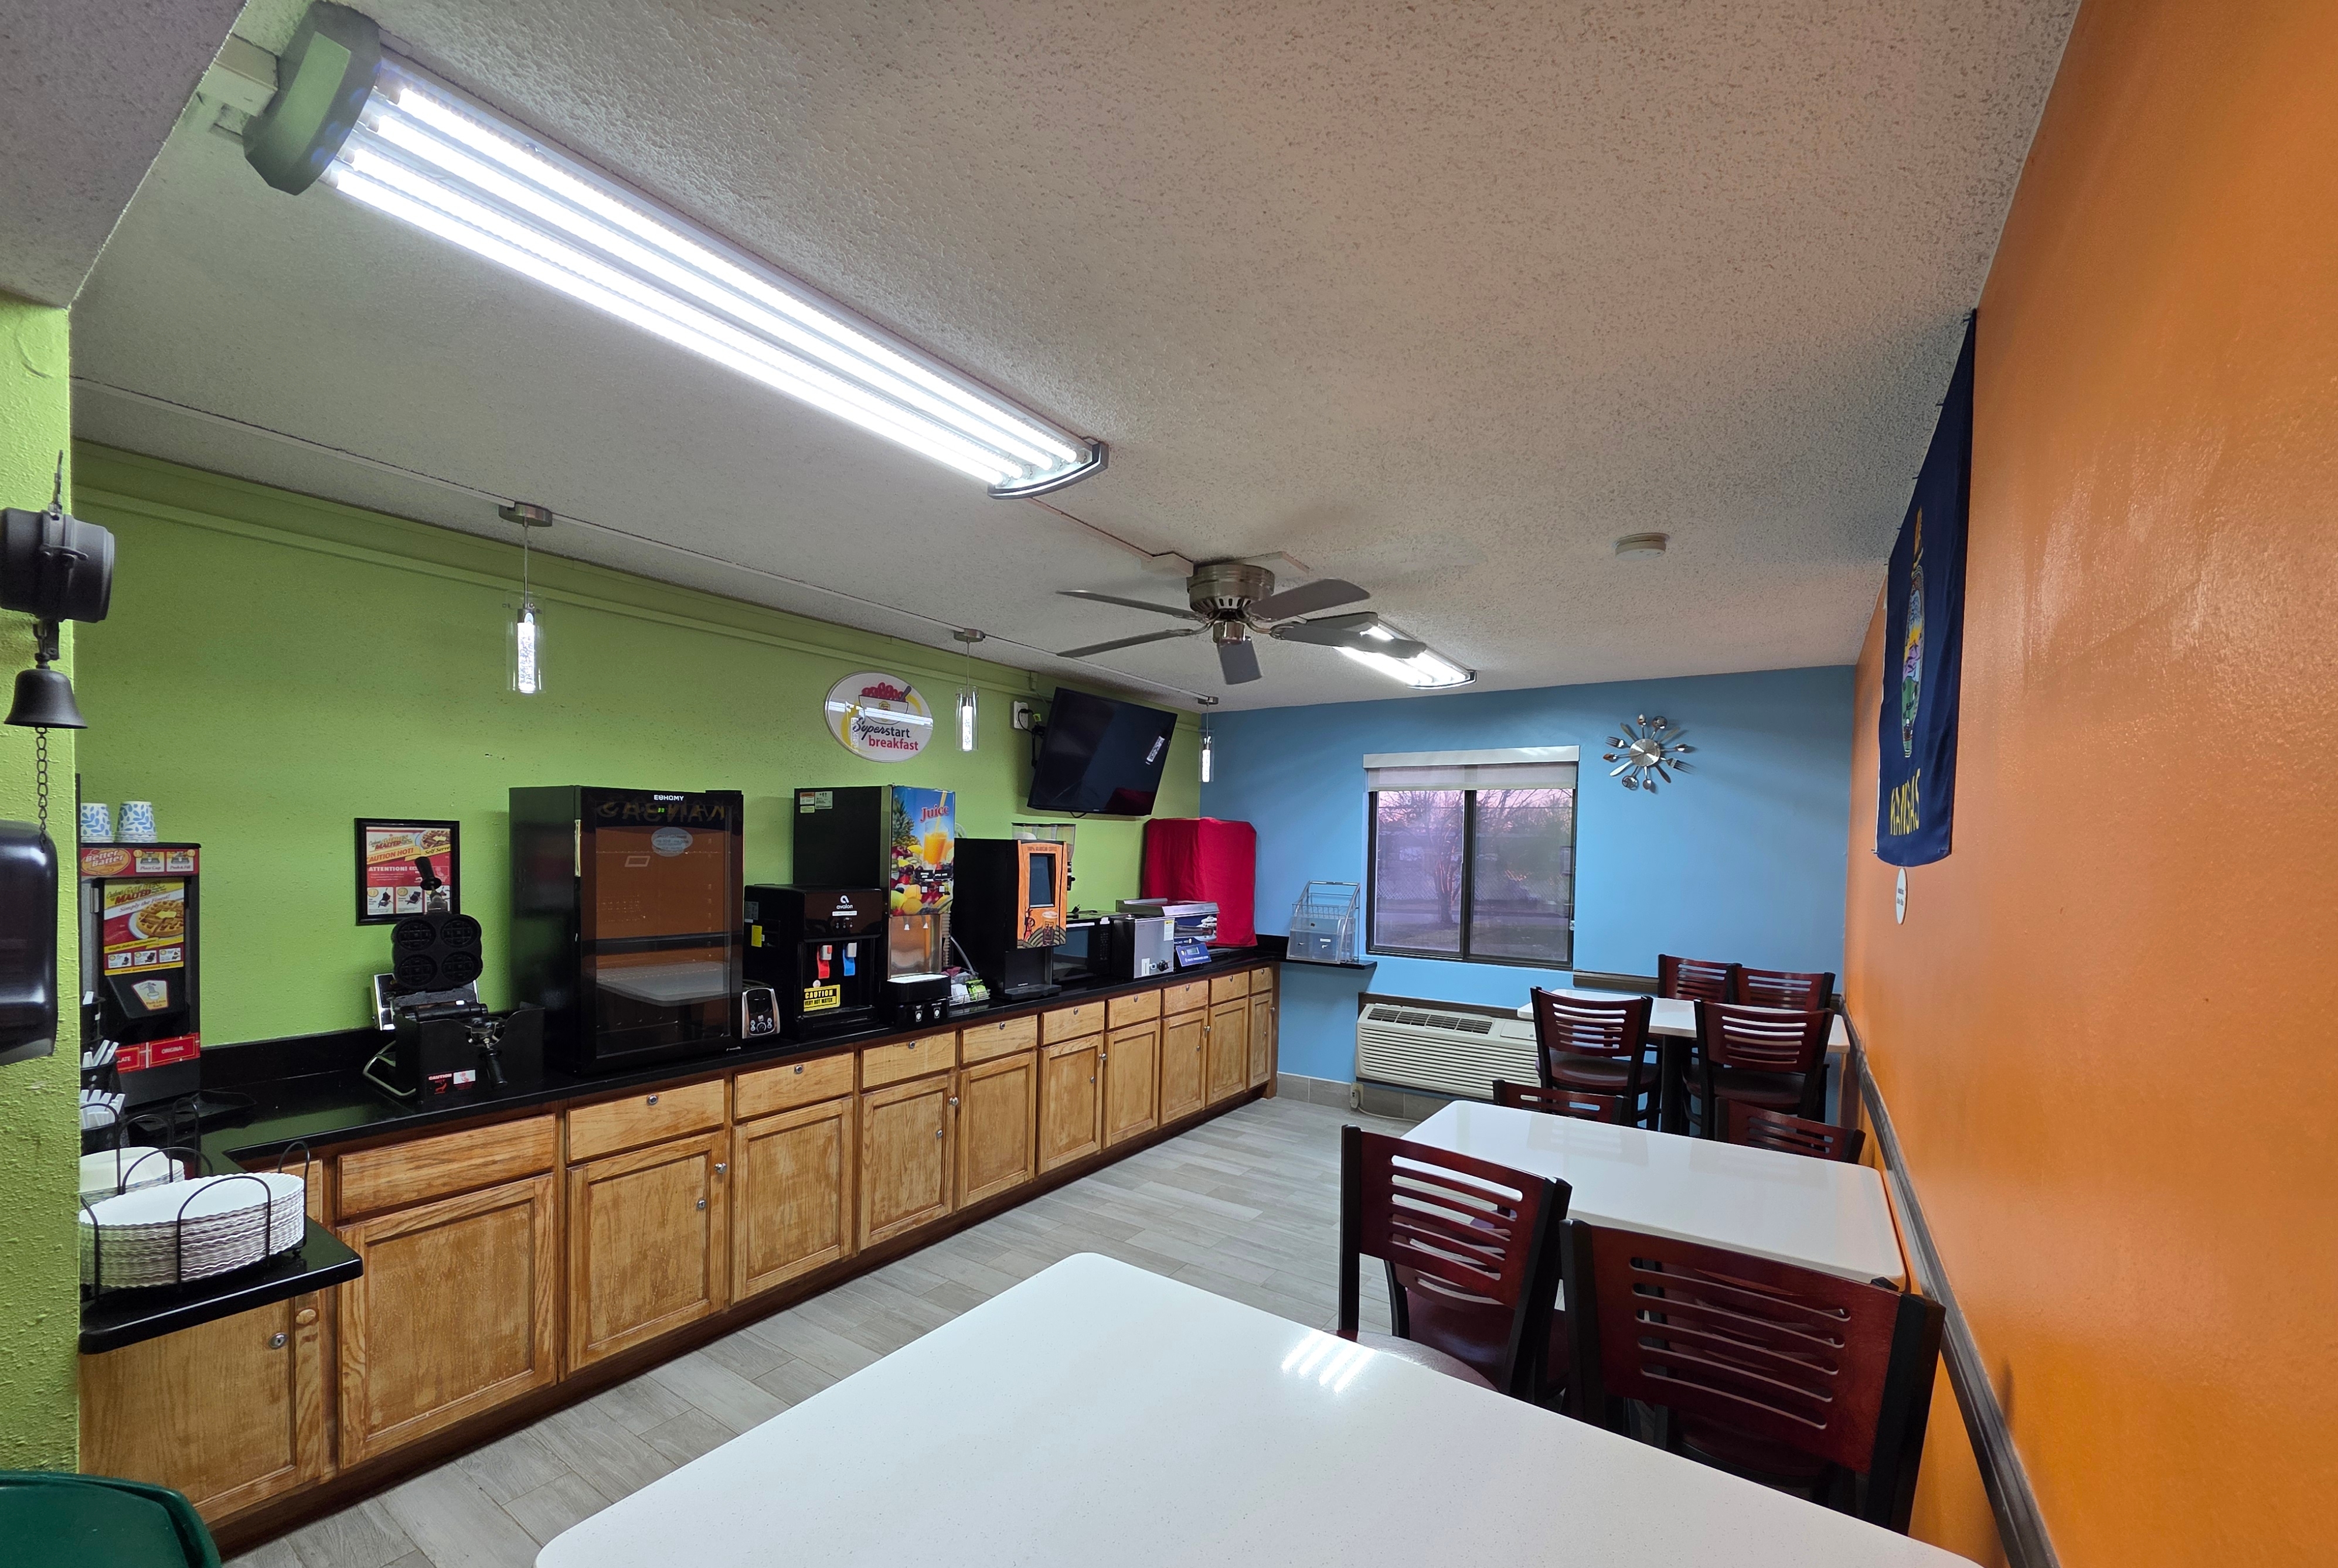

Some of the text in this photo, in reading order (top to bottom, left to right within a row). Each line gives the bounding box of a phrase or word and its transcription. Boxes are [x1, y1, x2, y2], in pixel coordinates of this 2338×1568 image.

[852, 717, 910, 741] Superstart
[869, 735, 919, 751] breakfast
[1890, 768, 1921, 836] KANSAS
[920, 804, 950, 823] Juice
[375, 841, 401, 850] MALTED
[397, 847, 414, 856] HOT!
[86, 850, 119, 863] Better
[92, 855, 124, 867] Batter
[115, 889, 151, 904] MALTED
[119, 902, 141, 912] Simply
[805, 990, 833, 999] CAUTION
[161, 1045, 184, 1054] ORIGINAL
